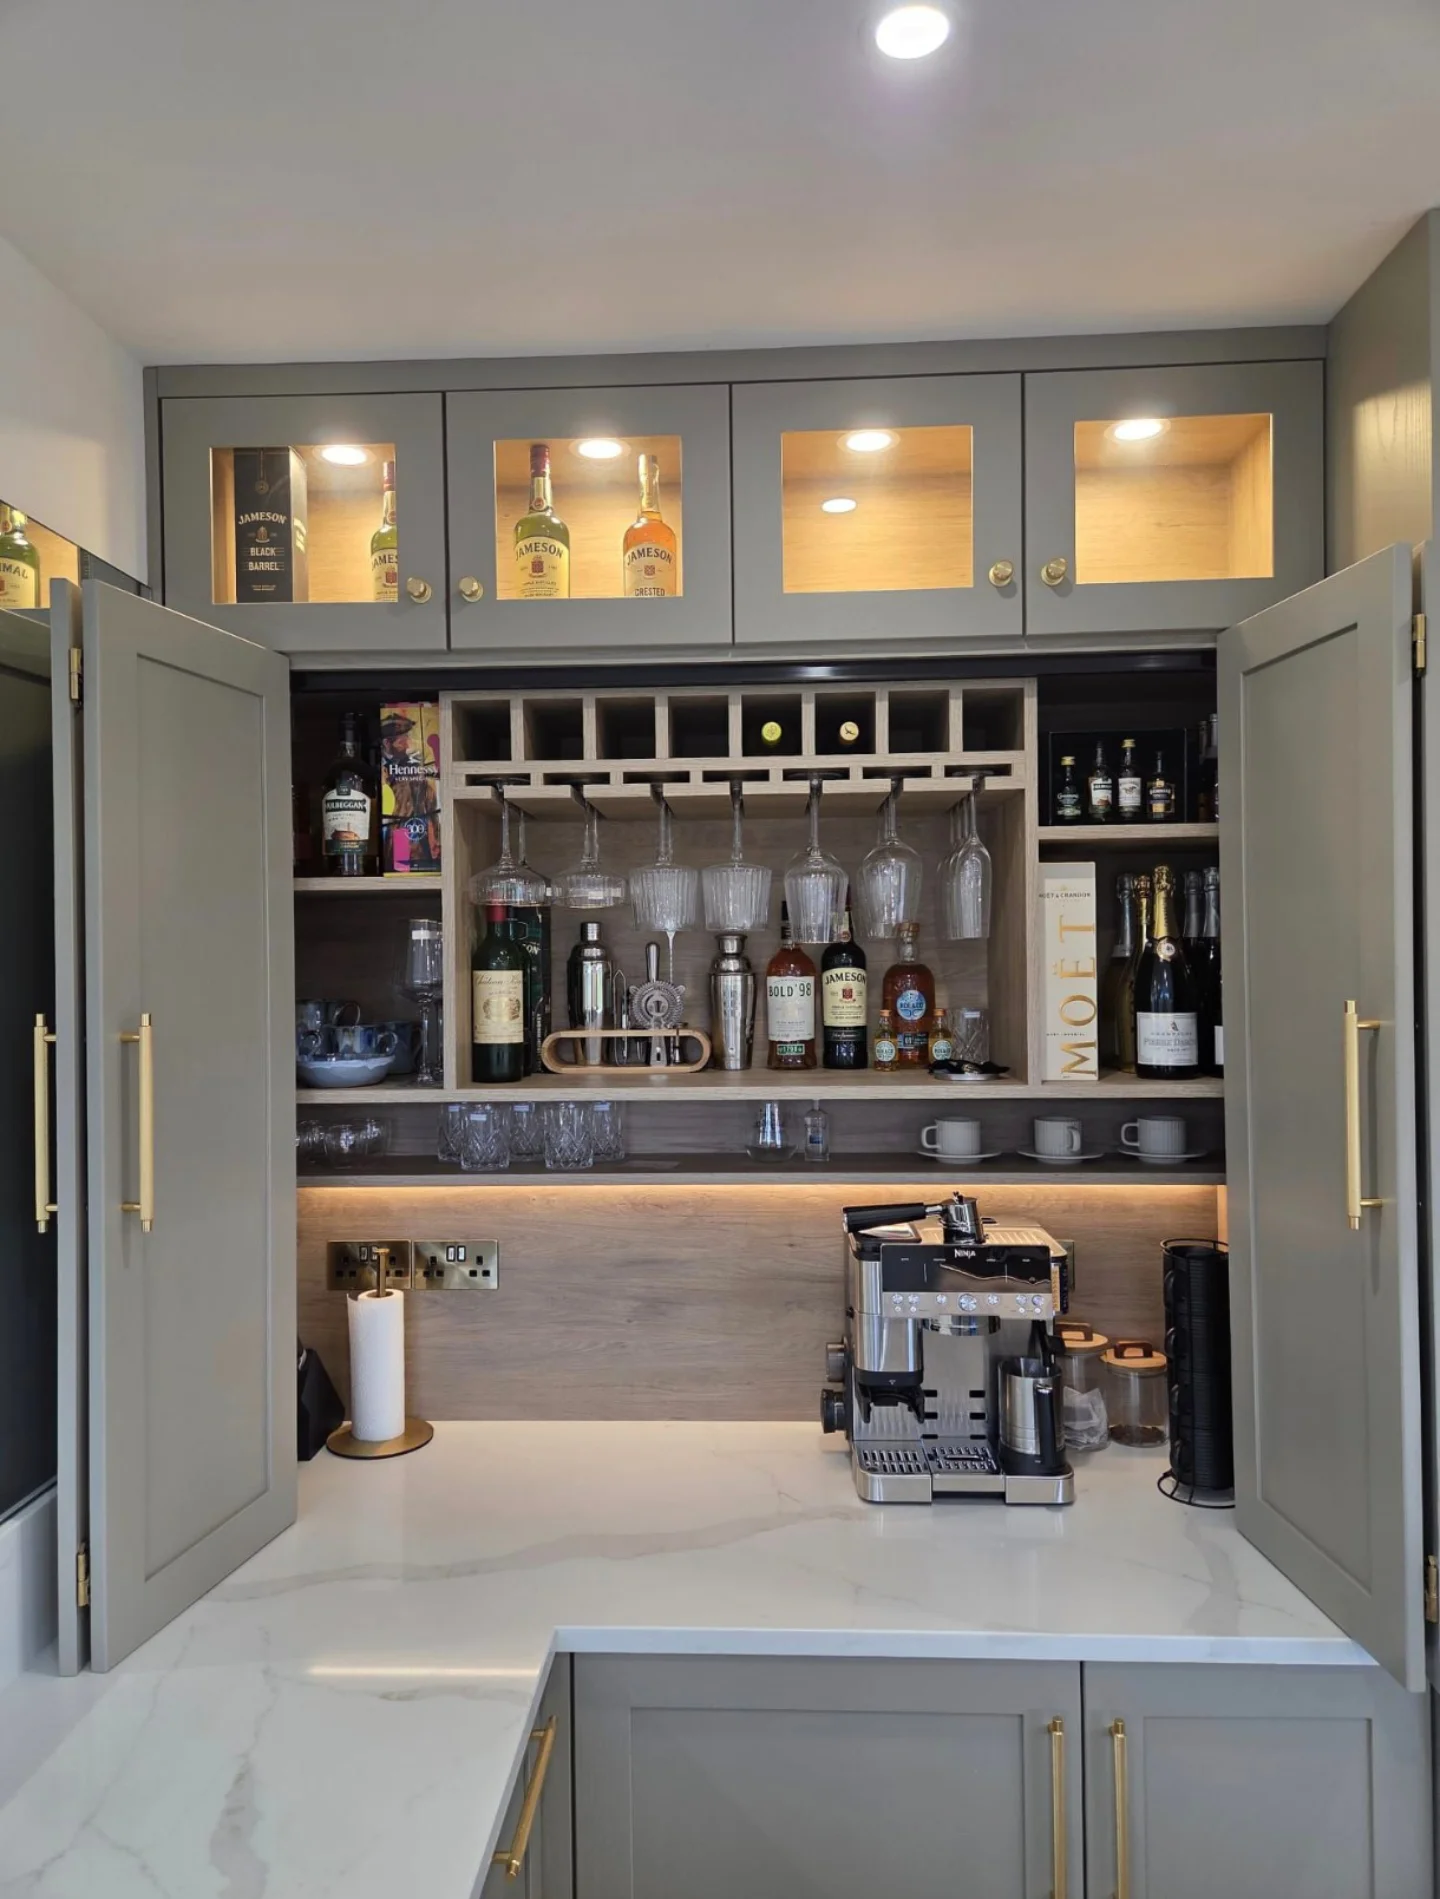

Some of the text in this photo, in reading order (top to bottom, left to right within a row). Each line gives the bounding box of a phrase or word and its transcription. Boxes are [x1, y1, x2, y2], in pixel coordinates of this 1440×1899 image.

[238, 512, 287, 525] JAMESON
[249, 547, 276, 557] BLACK
[516, 542, 564, 561] JAMESON
[627, 547, 672, 566] JAMESON
[248, 561, 280, 571] BARREL
[634, 587, 666, 597] CRESTED
[825, 971, 866, 986] JAMESON
[768, 985, 794, 997] BOLD
[954, 1248, 977, 1259] NINJA
